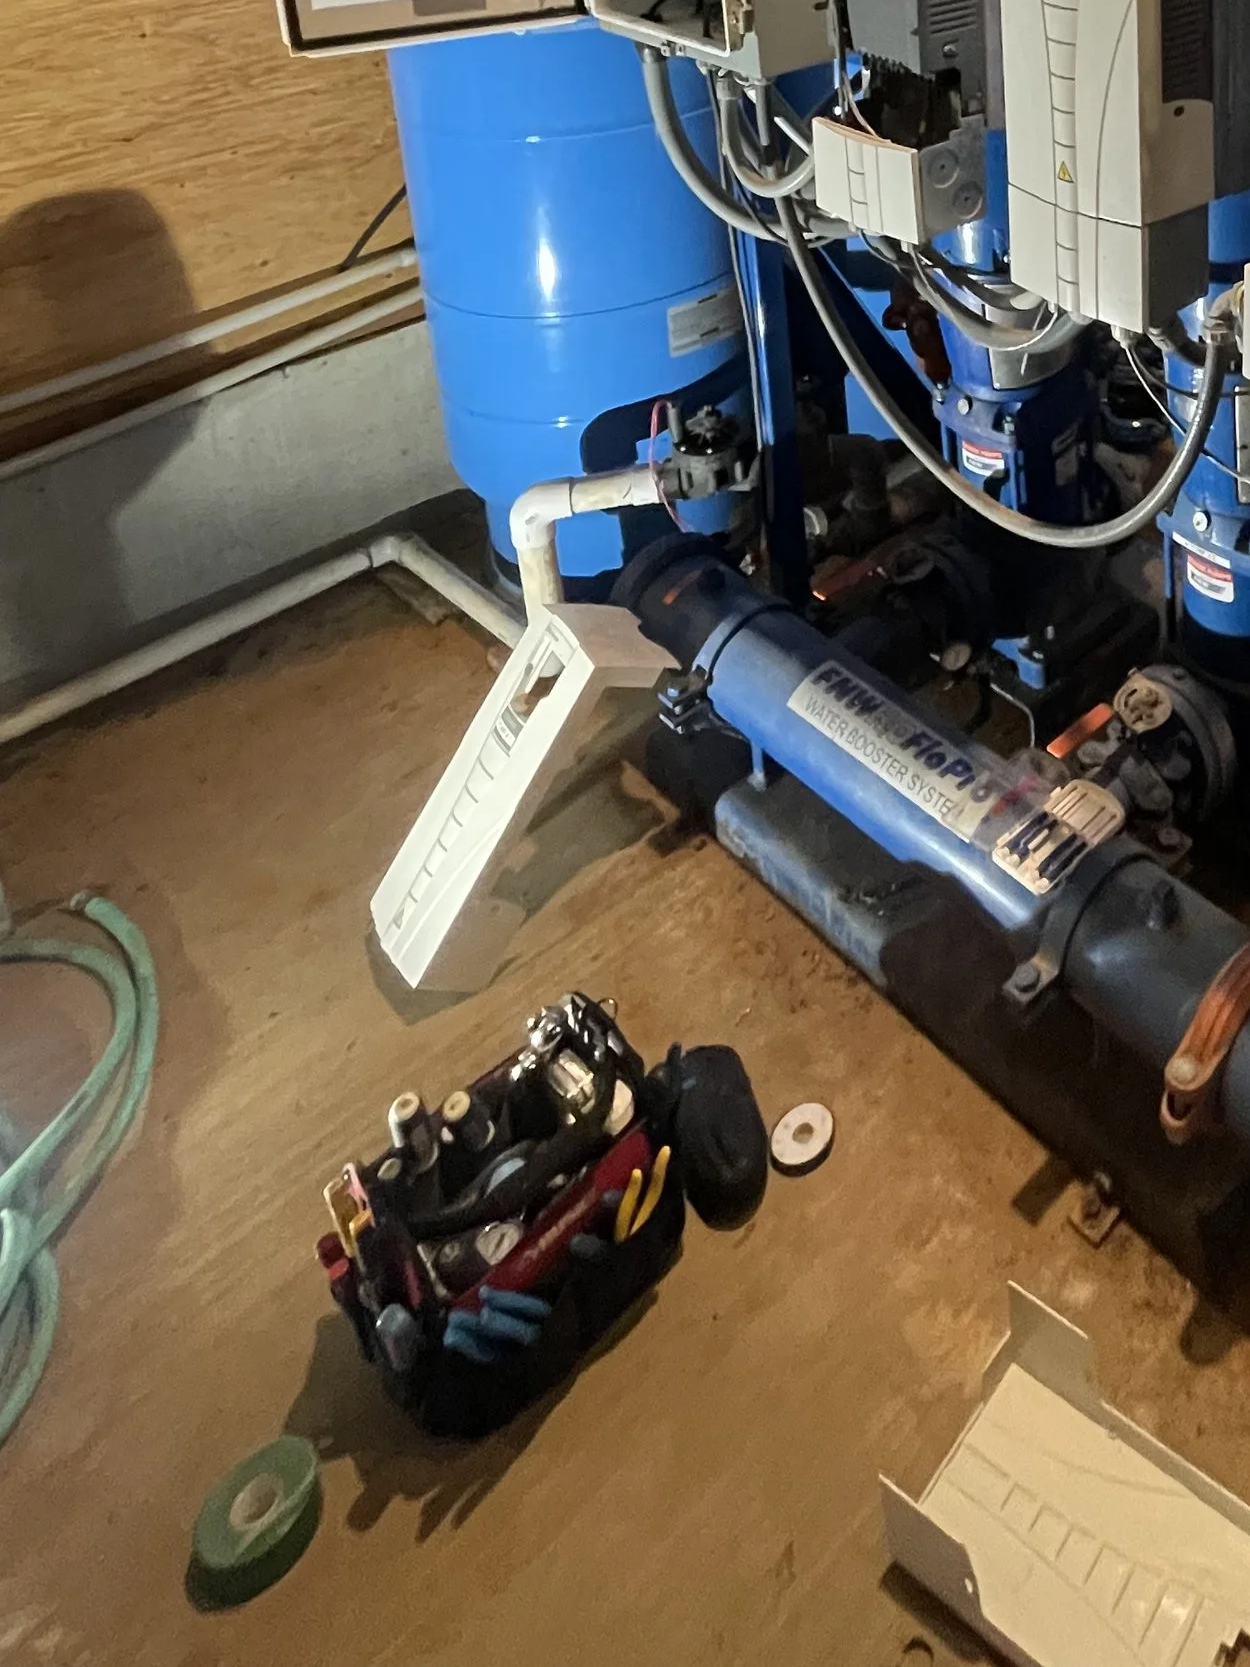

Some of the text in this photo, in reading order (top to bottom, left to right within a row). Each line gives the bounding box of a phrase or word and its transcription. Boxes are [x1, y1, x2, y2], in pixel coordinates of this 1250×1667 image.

[804, 695, 849, 740] WATER
[845, 727, 908, 785] BOOSTER
[901, 731, 993, 803] FloPro
